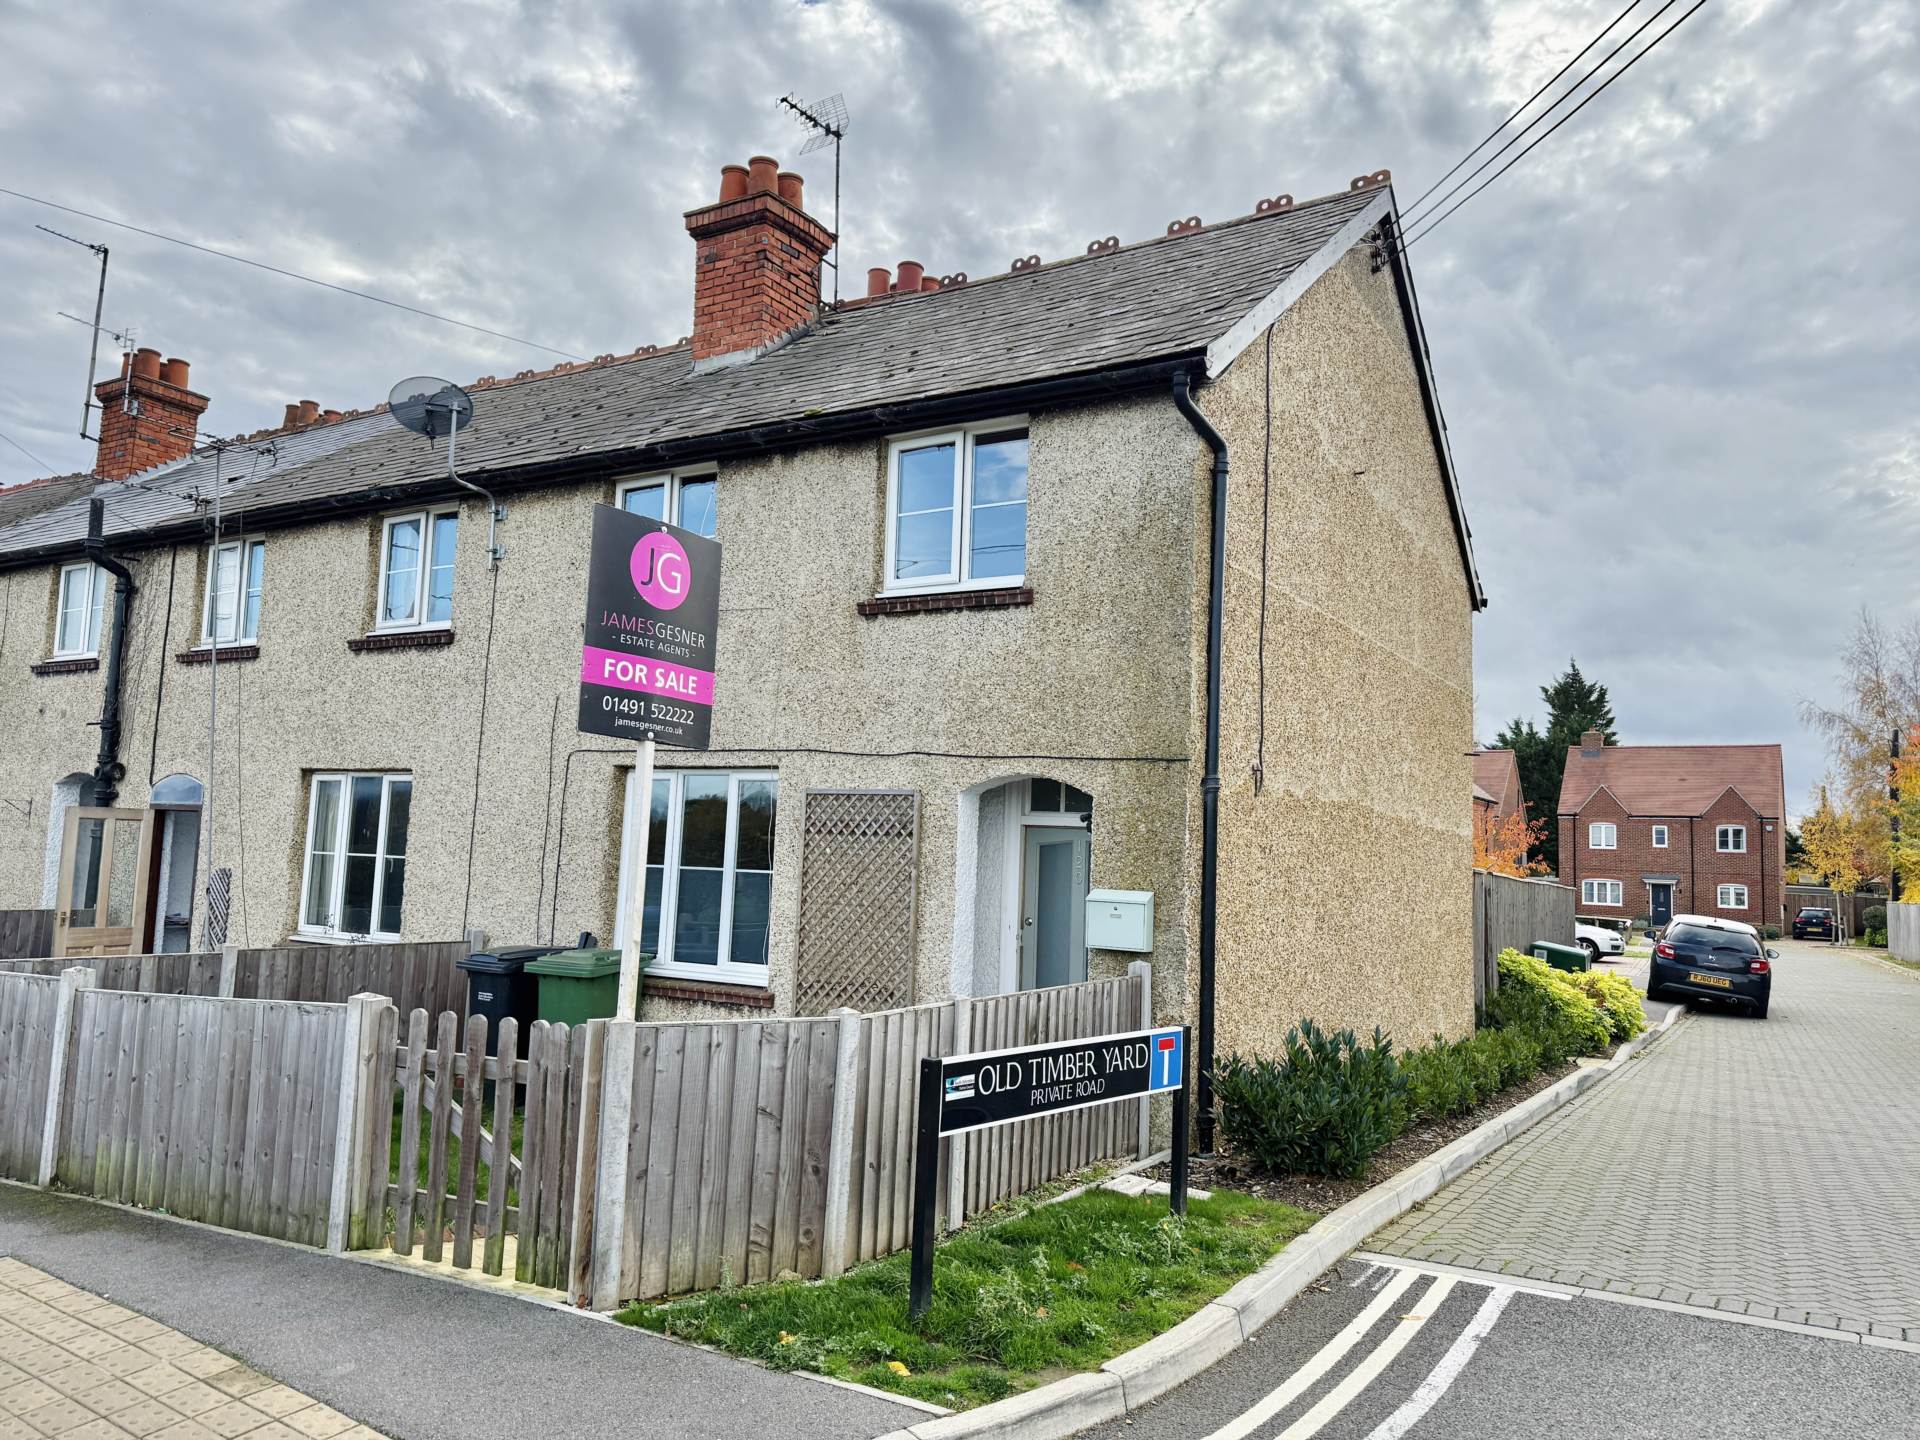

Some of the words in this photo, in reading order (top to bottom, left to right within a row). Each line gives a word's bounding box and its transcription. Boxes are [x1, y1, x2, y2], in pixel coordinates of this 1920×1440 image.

[640, 547, 682, 594] JG
[600, 610, 705, 649] JAMESGESNER
[620, 634, 654, 649] ESTATE
[657, 642, 690, 658] AGENTS
[604, 658, 647, 686] FOR
[655, 668, 698, 695] SALE
[602, 695, 645, 716] 01491
[651, 703, 694, 725] 522222
[614, 716, 683, 735] jamesgesner.co.uk
[978, 1061, 1022, 1096] OLD
[1028, 1050, 1098, 1086] TIMBER
[1102, 1043, 1149, 1075] YARD
[1030, 1087, 1073, 1107] PRIVATE
[1075, 1079, 1106, 1097] ROAD
